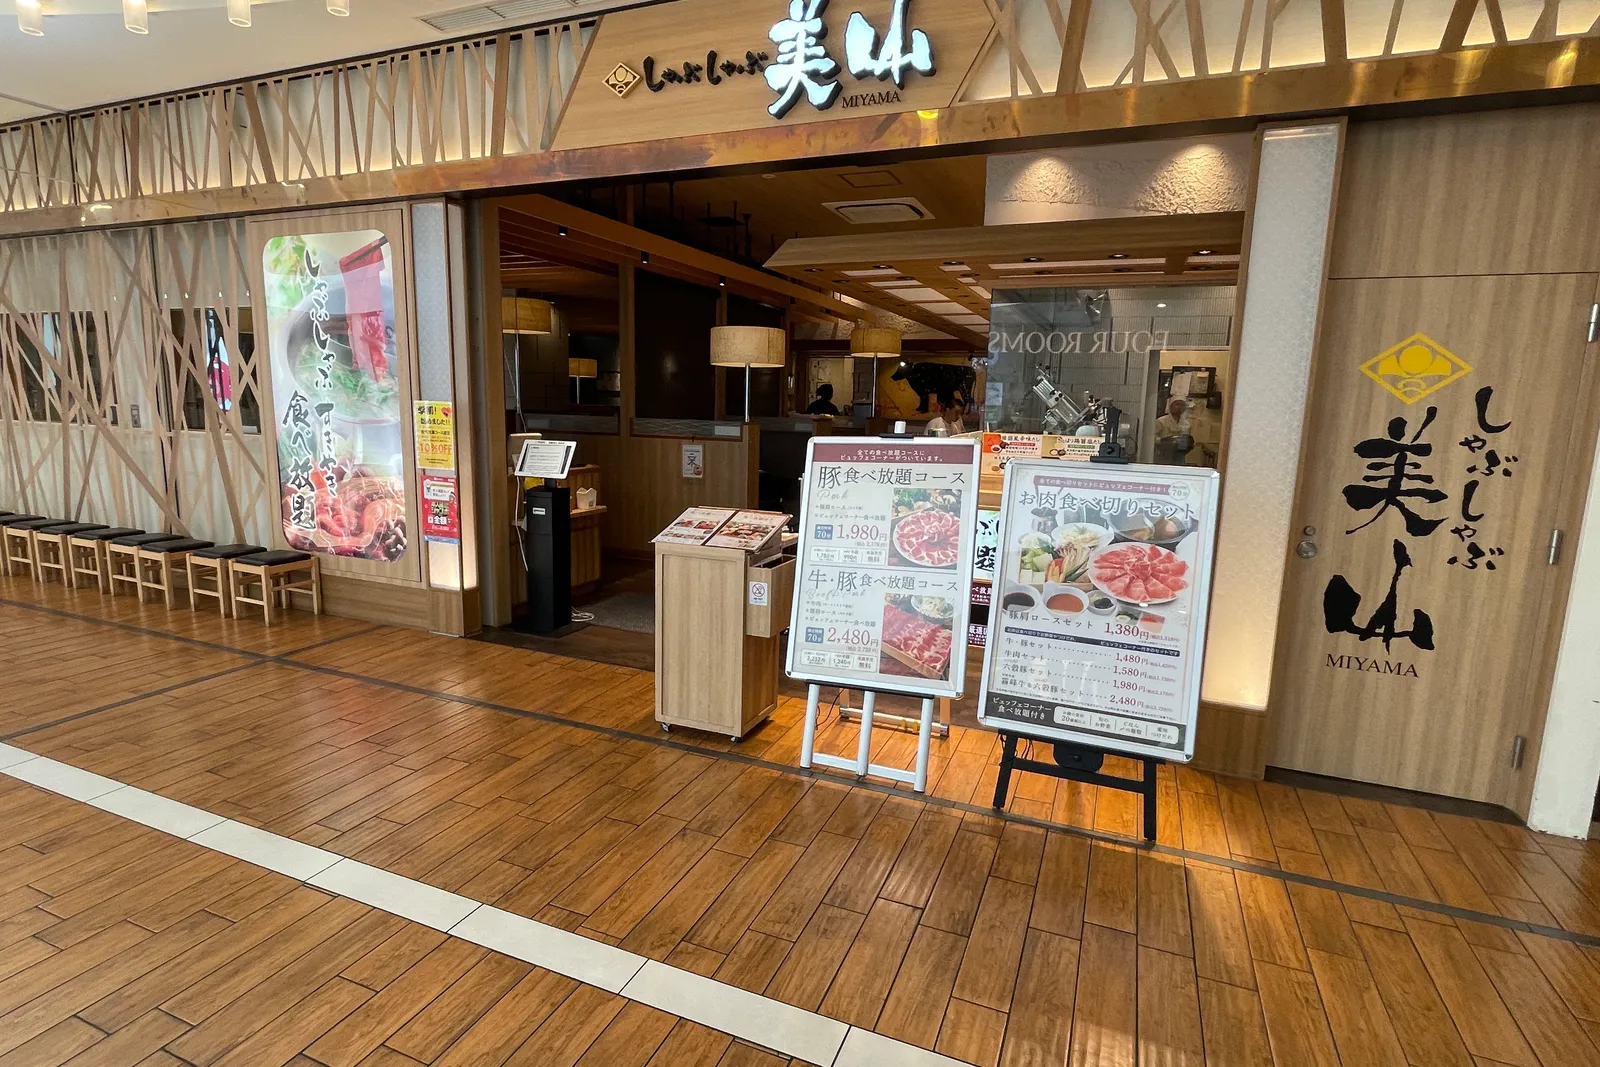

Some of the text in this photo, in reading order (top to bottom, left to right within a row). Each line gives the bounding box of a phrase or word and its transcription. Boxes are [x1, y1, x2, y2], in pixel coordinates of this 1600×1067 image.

[764, 0, 936, 120] 美山
[643, 51, 769, 92] しゃぶしゃぶ
[841, 90, 901, 109] MIYAMA
[304, 249, 336, 389] しゃぶしゃぶ
[282, 390, 317, 529] 食べ放題
[840, 454, 943, 462] ビュッフェコーナーがついています。
[817, 466, 965, 489] 豚食べ放題コース
[1447, 386, 1518, 570] しゃぶしゃぶ
[1018, 490, 1196, 521] お肉食べ切りセット
[837, 524, 887, 541] 1,980円
[1324, 406, 1449, 655] 美山
[1008, 609, 1093, 629] 豚肩ロースセット
[827, 627, 878, 647] 2,480円
[1104, 622, 1149, 640] 1,380円
[1004, 649, 1044, 662] 牛肉セット
[1113, 665, 1147, 678] 1,580円
[1115, 652, 1148, 665] 1,480円
[1325, 653, 1419, 678] MIYAMA
[1112, 679, 1145, 692] 1,980円
[993, 697, 1051, 711] ビュッフェコーナー
[1110, 694, 1144, 708] 2,480円
[998, 705, 1045, 719] 食べ放題付き
